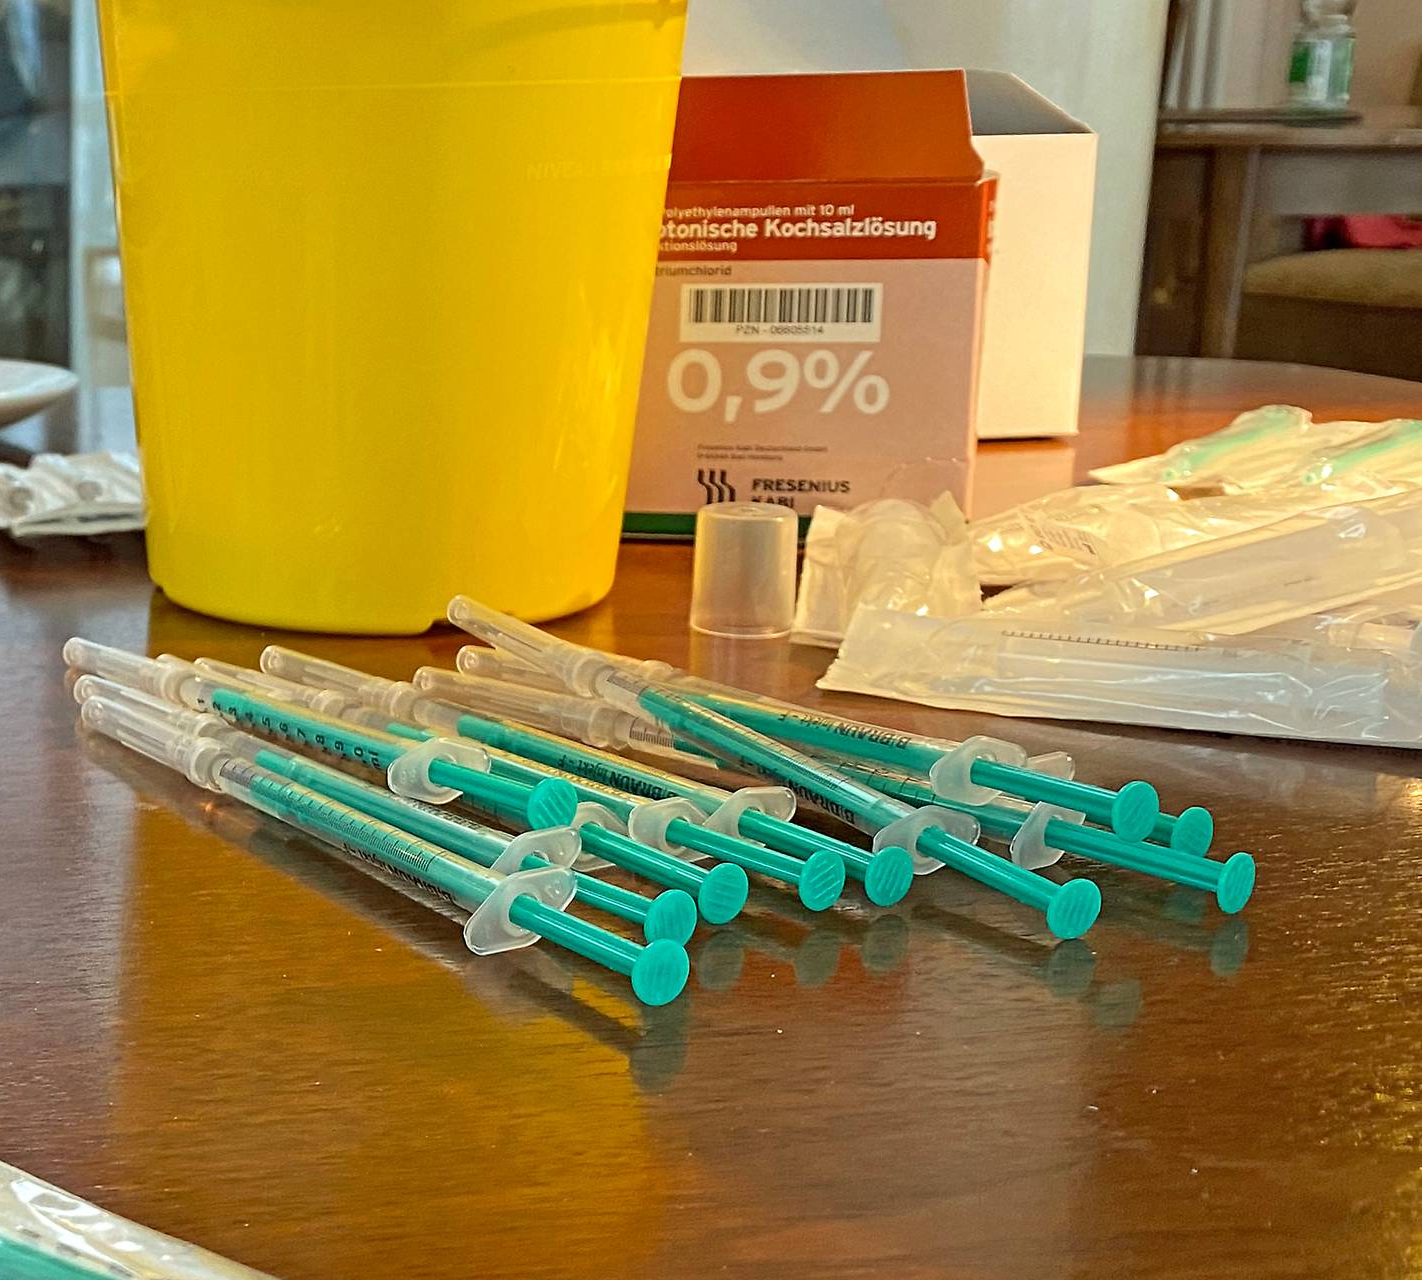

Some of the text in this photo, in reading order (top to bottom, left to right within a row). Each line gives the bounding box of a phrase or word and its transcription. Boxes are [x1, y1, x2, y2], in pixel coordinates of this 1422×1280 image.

[664, 203, 855, 219] olyethylenampullen mit 10 ml
[765, 217, 937, 241] Kochsalzlösung
[736, 324, 760, 336] PZN
[666, 347, 891, 423] 0,9%
[752, 478, 851, 494] FRESENIUS
